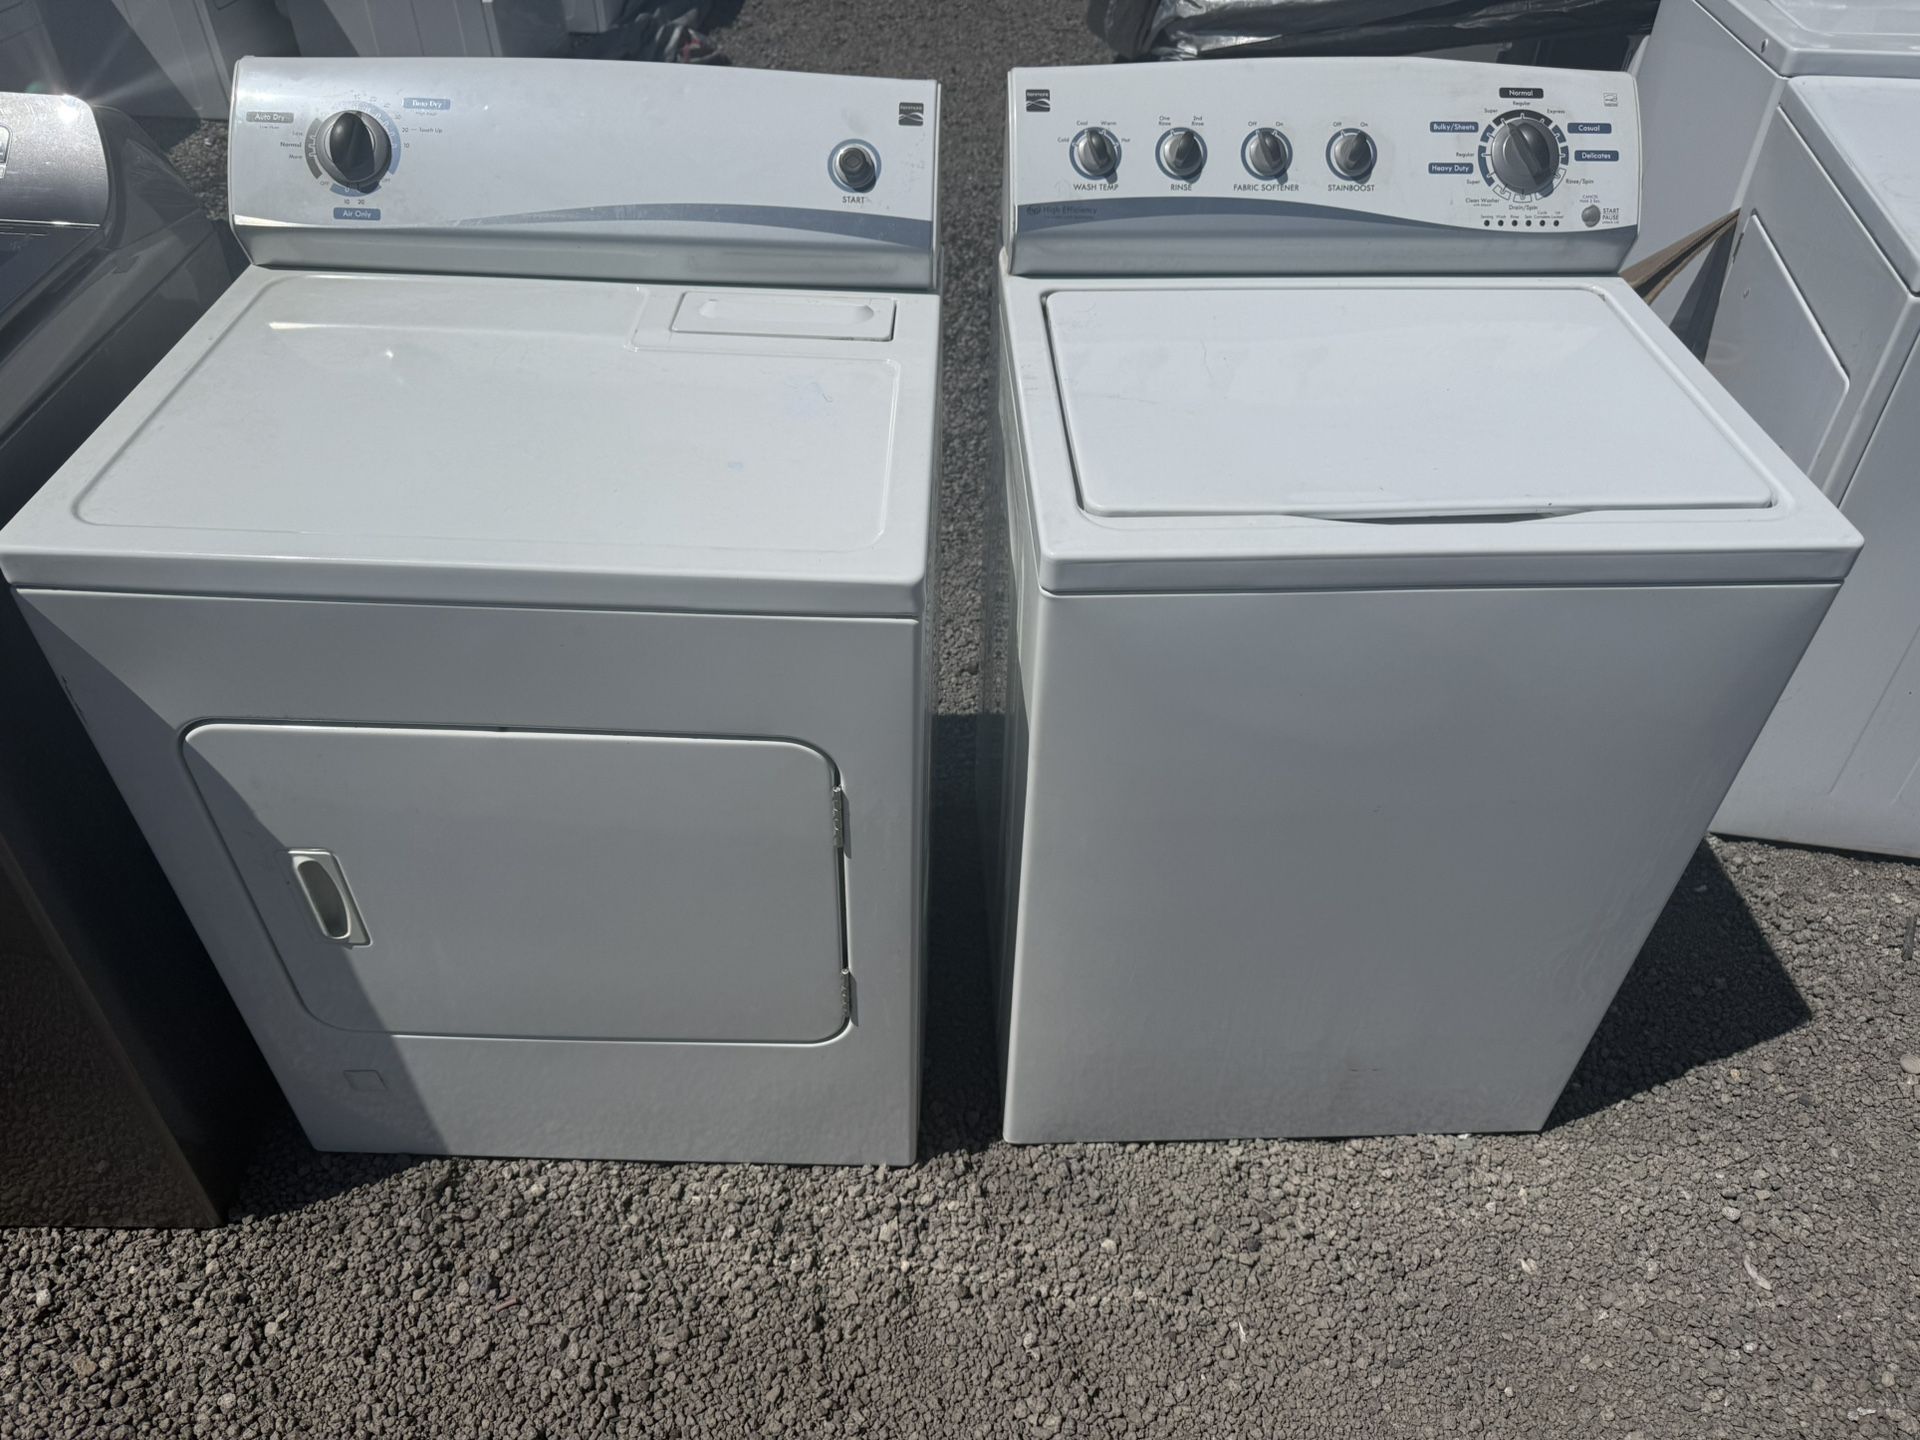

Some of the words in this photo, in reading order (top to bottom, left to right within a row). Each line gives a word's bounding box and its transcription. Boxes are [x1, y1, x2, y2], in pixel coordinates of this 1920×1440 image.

[254, 113, 271, 121] Auto
[272, 113, 285, 122] Dry
[1433, 123, 1475, 132] Bulky/Sheets
[1578, 124, 1600, 132] Casual
[1581, 151, 1611, 159] Delicates
[1431, 164, 1453, 173] Heavy
[1454, 164, 1470, 173] Duty
[1073, 183, 1097, 191] WASH
[1099, 183, 1119, 191] TEMP
[1171, 183, 1192, 191] RINSE
[1233, 184, 1259, 192] FABRIC
[1261, 184, 1299, 192] SOFTENER
[1328, 184, 1375, 192] STAINBOOST
[354, 210, 372, 219] Only
